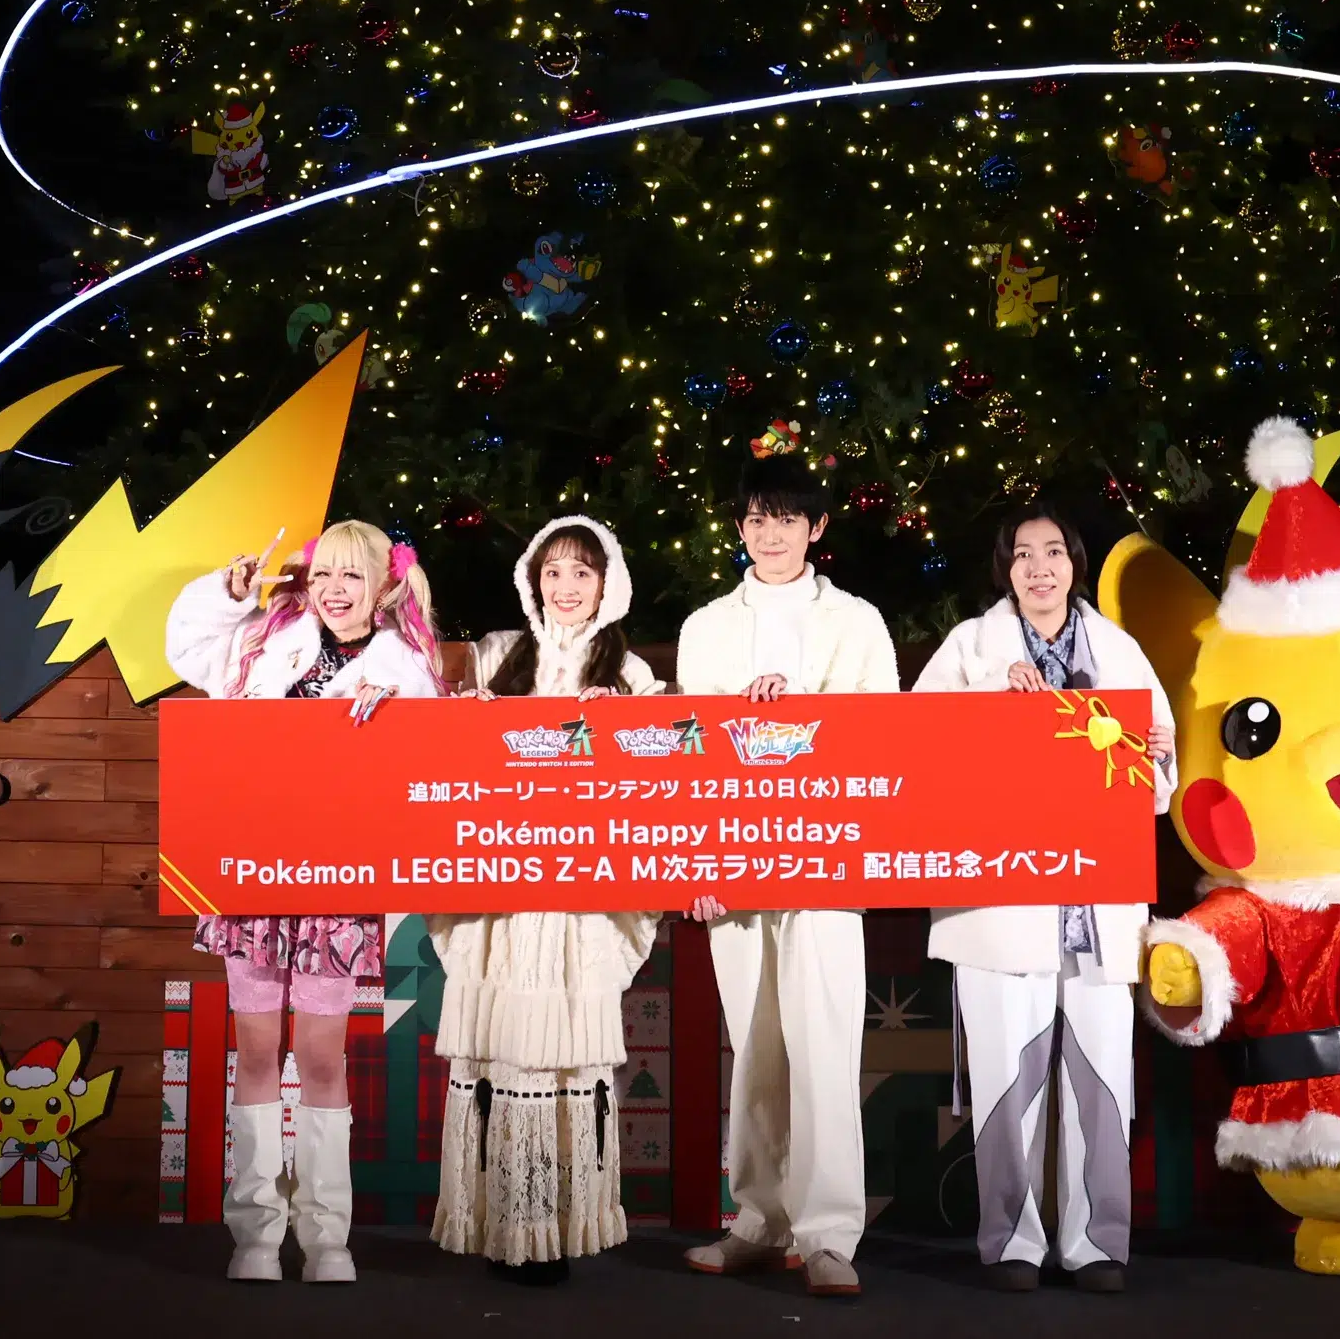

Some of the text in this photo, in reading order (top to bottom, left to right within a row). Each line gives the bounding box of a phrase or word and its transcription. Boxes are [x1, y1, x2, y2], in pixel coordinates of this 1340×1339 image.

[521, 749, 558, 757] LEGENDS
[633, 748, 669, 756] LEGENDS
[407, 780, 679, 802] 追加ストーリー・コンテンツ
[456, 816, 861, 851] Pokémon Happy Holidays
[392, 857, 544, 884] LEGENDS
[555, 856, 616, 882] Z-A
[863, 848, 1097, 880] 配信記念イベント
